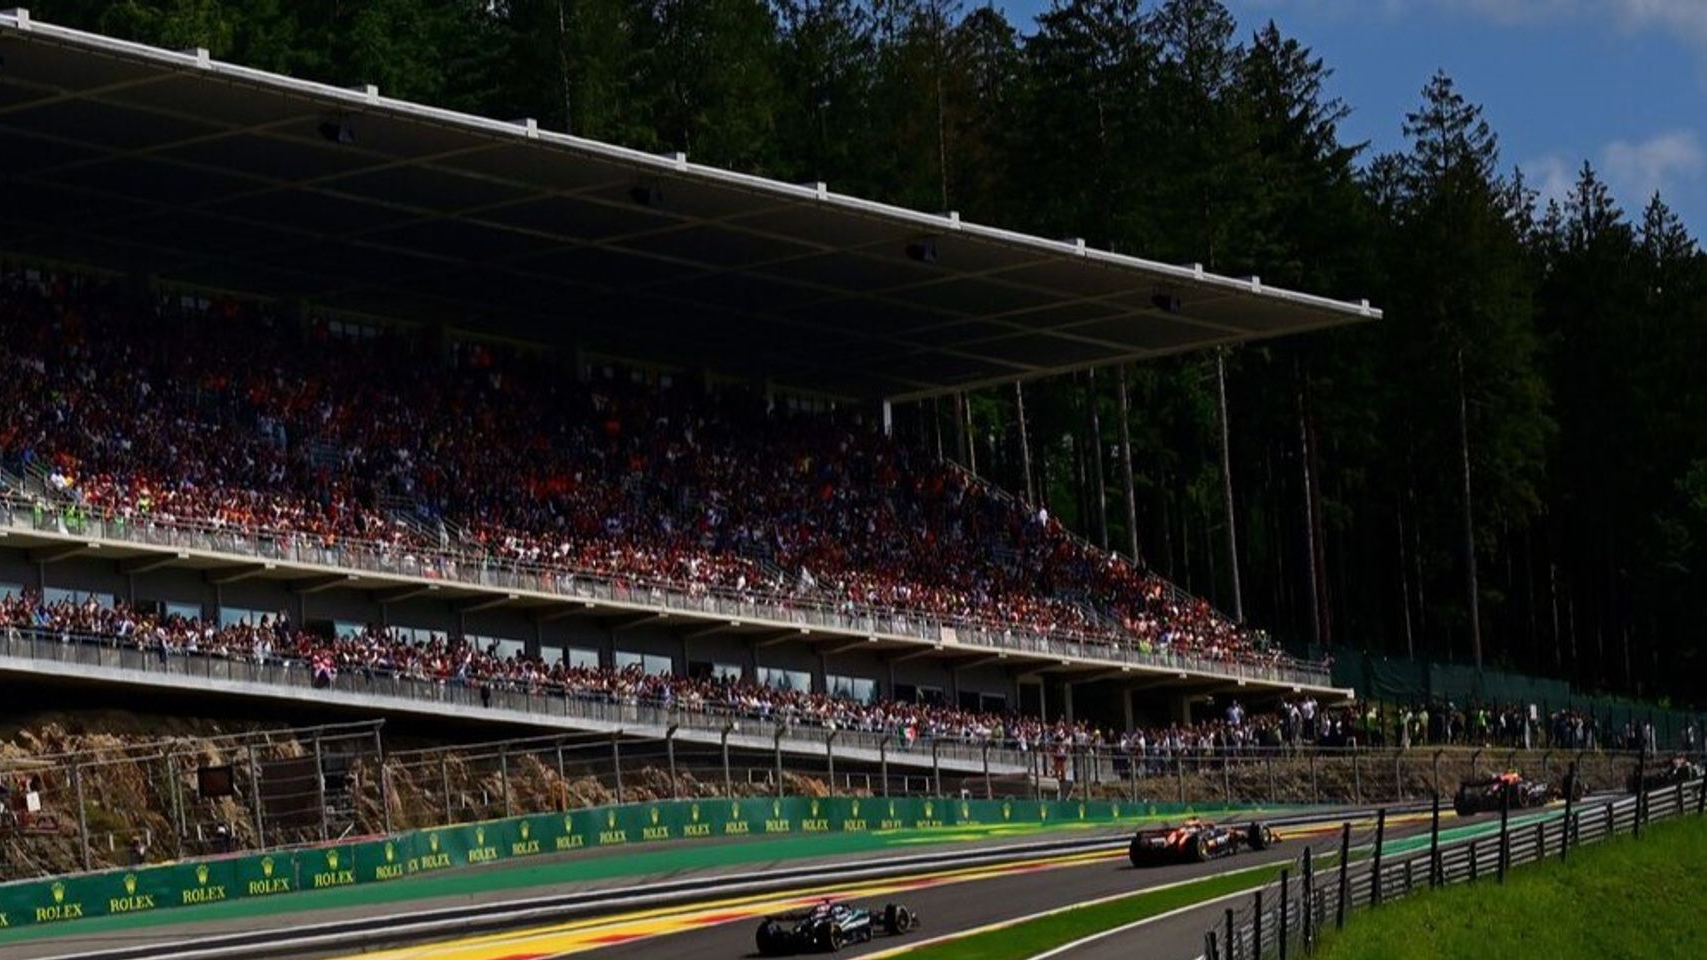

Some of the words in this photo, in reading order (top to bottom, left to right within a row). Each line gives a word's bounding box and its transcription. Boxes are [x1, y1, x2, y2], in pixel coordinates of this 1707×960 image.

[600, 830, 626, 845] ROLEX
[643, 826, 669, 840] ROLEX
[512, 840, 540, 856] ROLEX
[556, 834, 584, 849] ROLEX
[422, 853, 450, 869] ROLEX
[469, 847, 497, 863] ROLEX
[249, 878, 289, 895] ROLEX
[315, 870, 354, 887] ROLEX
[182, 886, 226, 904] ROLEX
[110, 895, 155, 913] ROLEX
[36, 903, 83, 923] ROLEX
